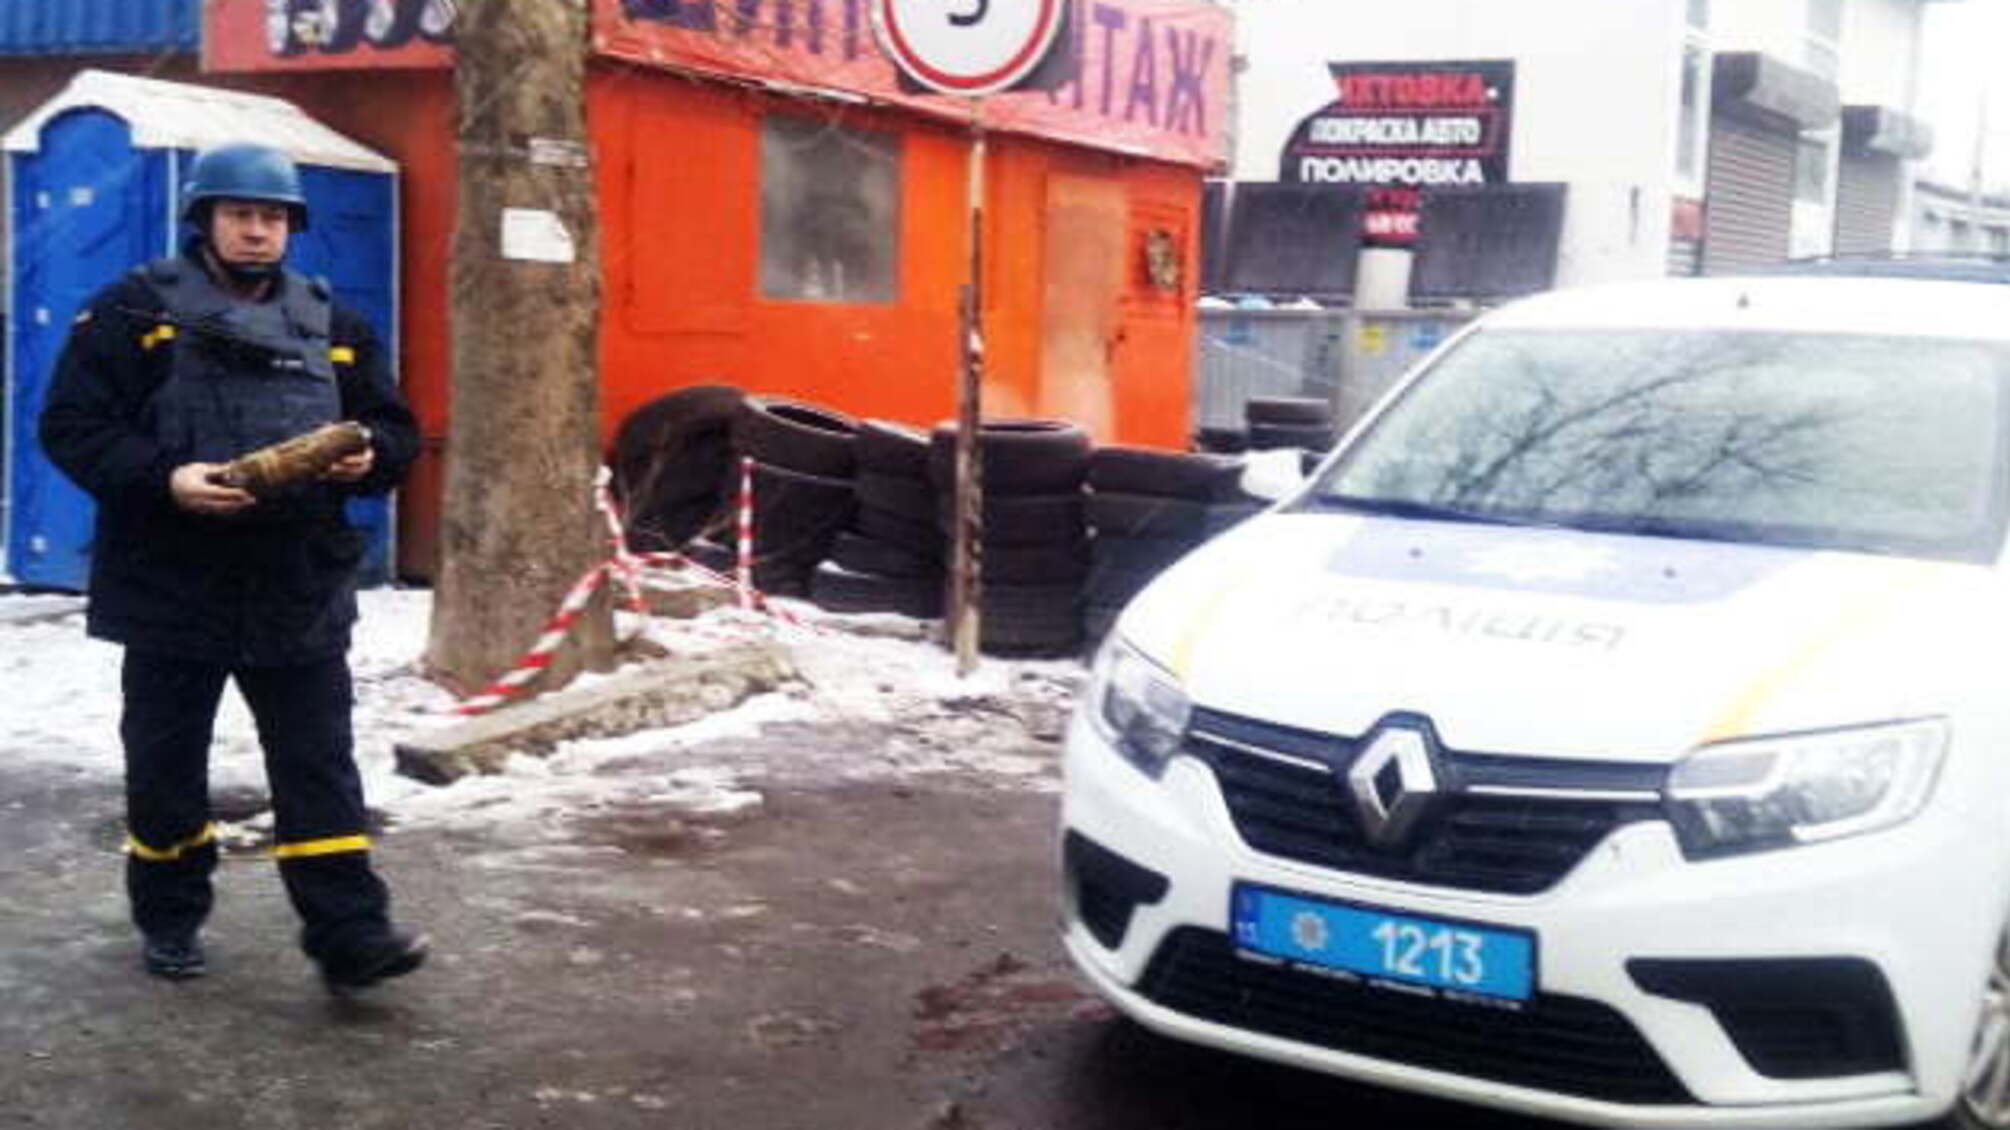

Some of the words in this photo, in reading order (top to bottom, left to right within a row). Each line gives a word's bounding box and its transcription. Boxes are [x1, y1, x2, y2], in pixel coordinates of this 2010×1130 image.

[1420, 117, 1481, 144] АВТО
[1301, 157, 1484, 183] ПОЛИРОВКА
[1372, 920, 1483, 984] 1213
